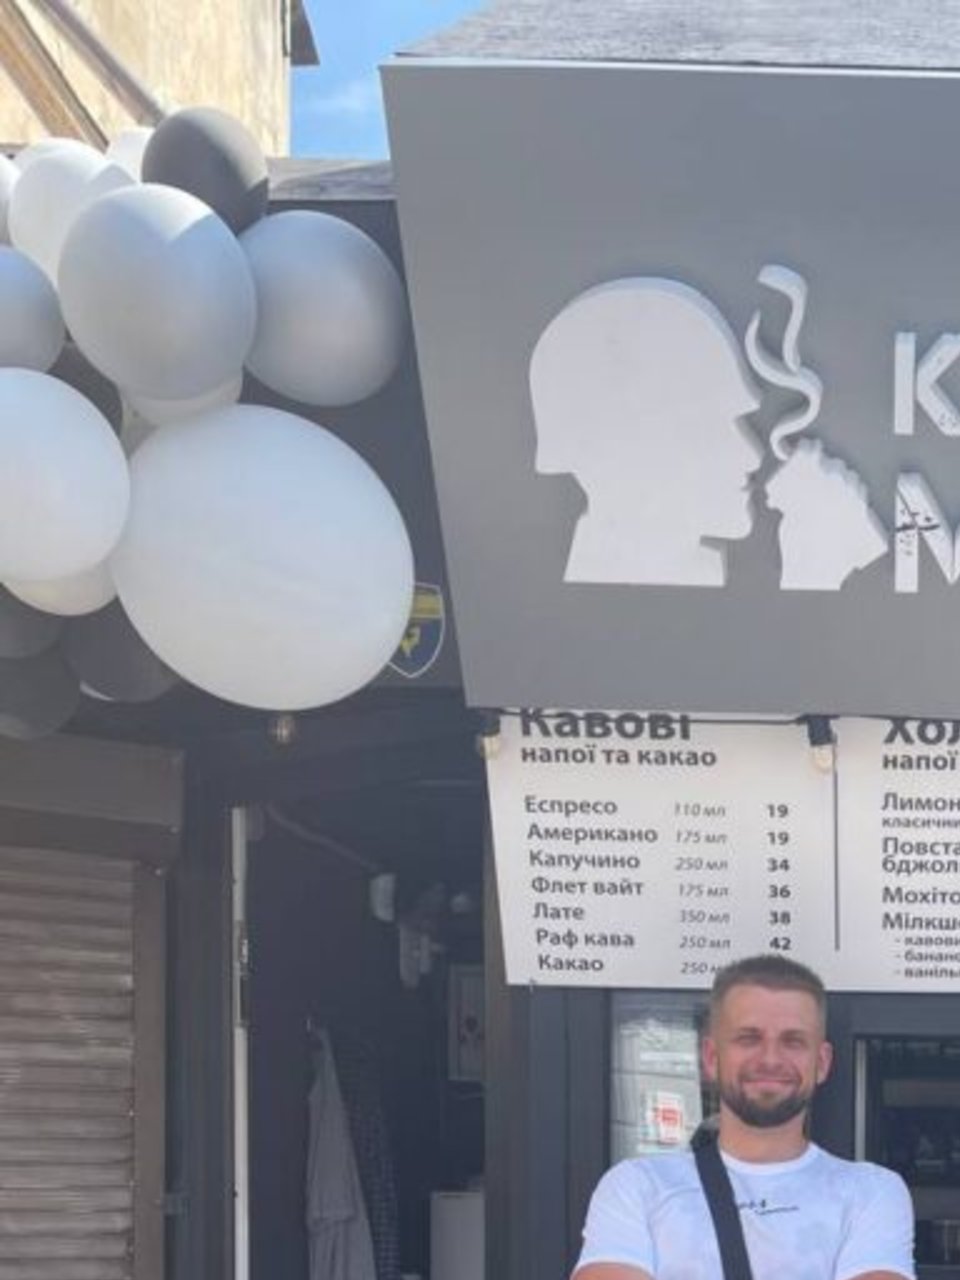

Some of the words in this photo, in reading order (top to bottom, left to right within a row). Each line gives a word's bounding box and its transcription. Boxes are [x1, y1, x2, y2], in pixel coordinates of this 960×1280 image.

[520, 707, 691, 741] Кавові
[521, 744, 596, 764] напої
[602, 749, 630, 765] та
[638, 750, 717, 766] какао
[882, 751, 959, 771] напої
[524, 795, 618, 816] Еспресо
[767, 804, 789, 818] 19
[527, 823, 658, 845] Американо
[767, 832, 790, 845] 19
[529, 850, 641, 872] Капучино
[767, 858, 791, 872] 34
[531, 876, 587, 896] Флет
[593, 879, 644, 897] вайт
[768, 885, 792, 898] 36
[532, 902, 586, 921] Лате
[768, 911, 792, 925] 38
[536, 928, 579, 950] Раф
[583, 934, 636, 948] кава
[769, 937, 792, 951] 42
[538, 954, 604, 972] Какао
